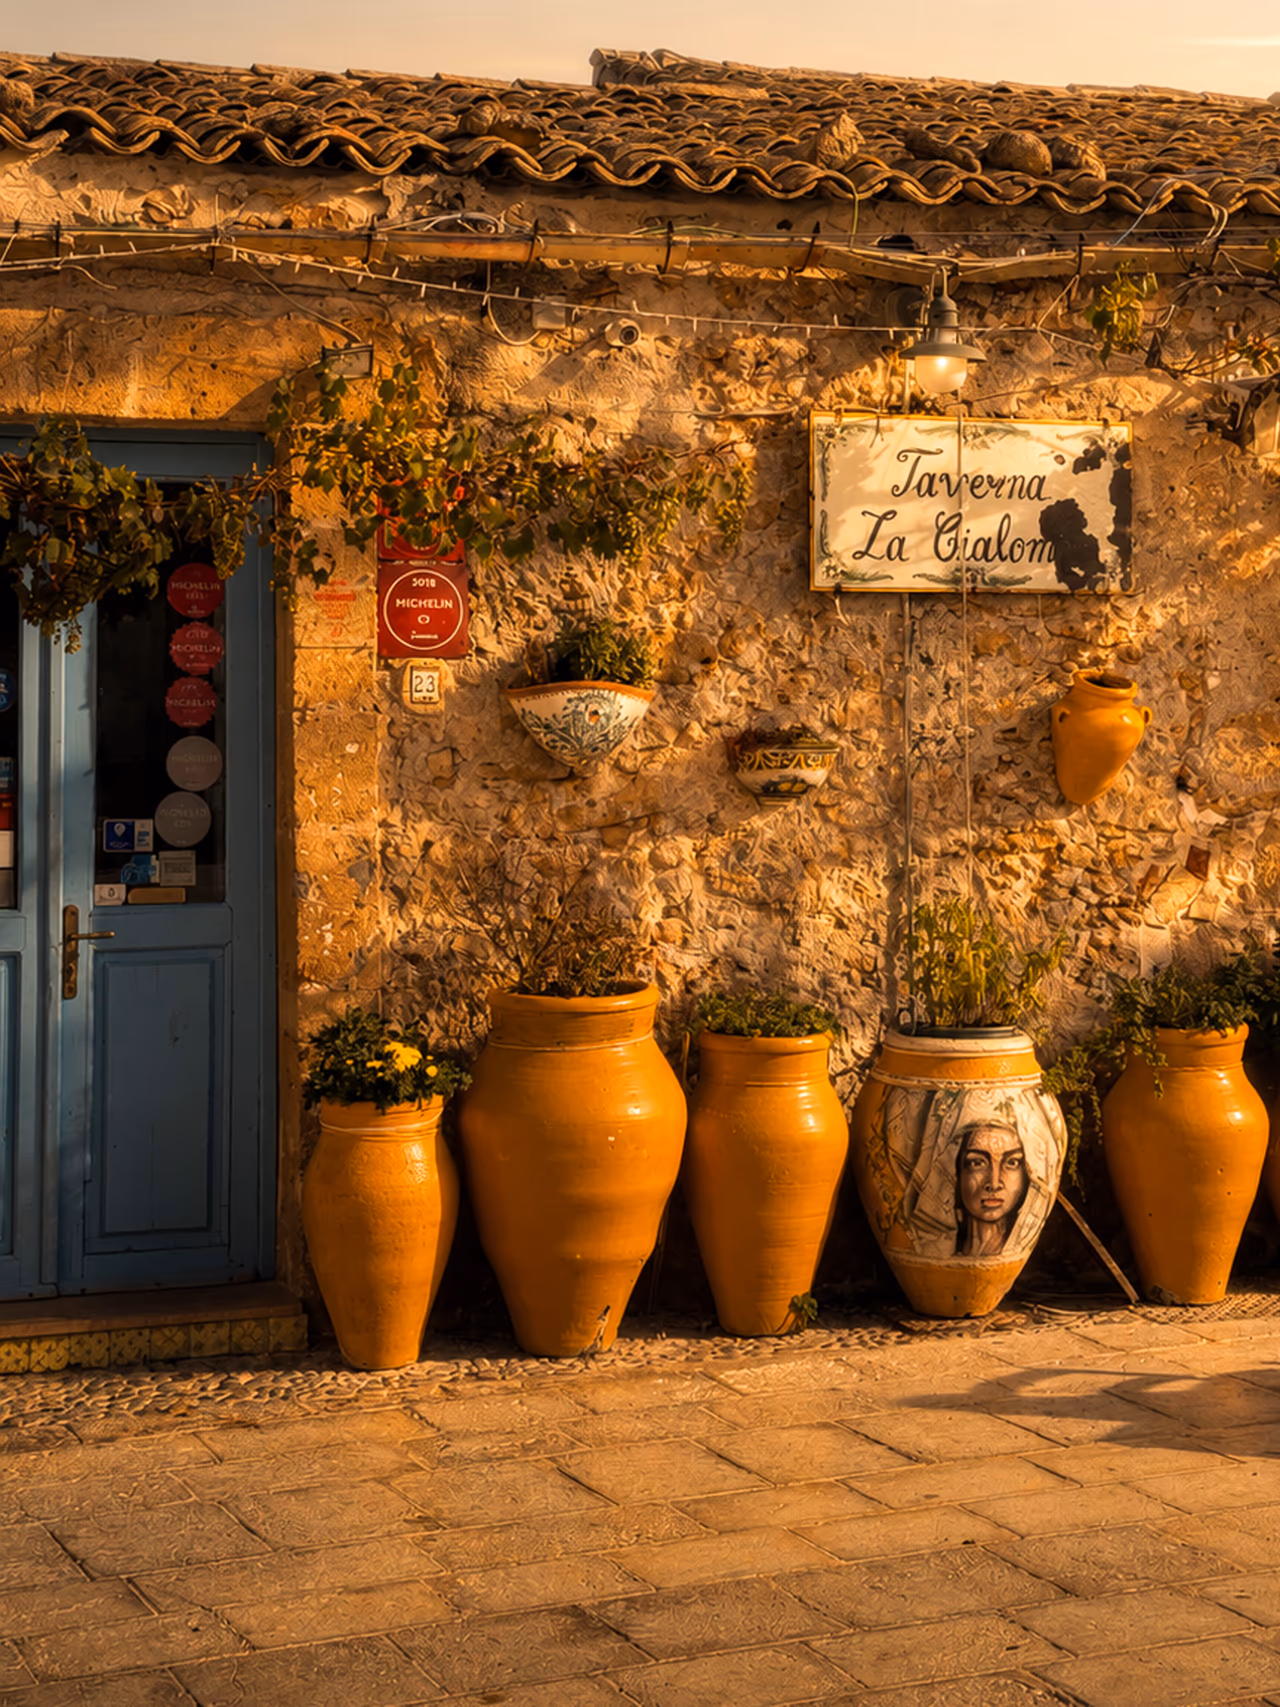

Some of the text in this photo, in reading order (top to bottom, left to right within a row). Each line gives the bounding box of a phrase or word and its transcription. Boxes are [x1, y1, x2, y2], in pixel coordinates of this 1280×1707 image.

[891, 448, 1051, 501] Taverna
[852, 509, 1057, 563] La Cialom
[395, 598, 453, 609] MICHELIN
[414, 675, 435, 693] 23
